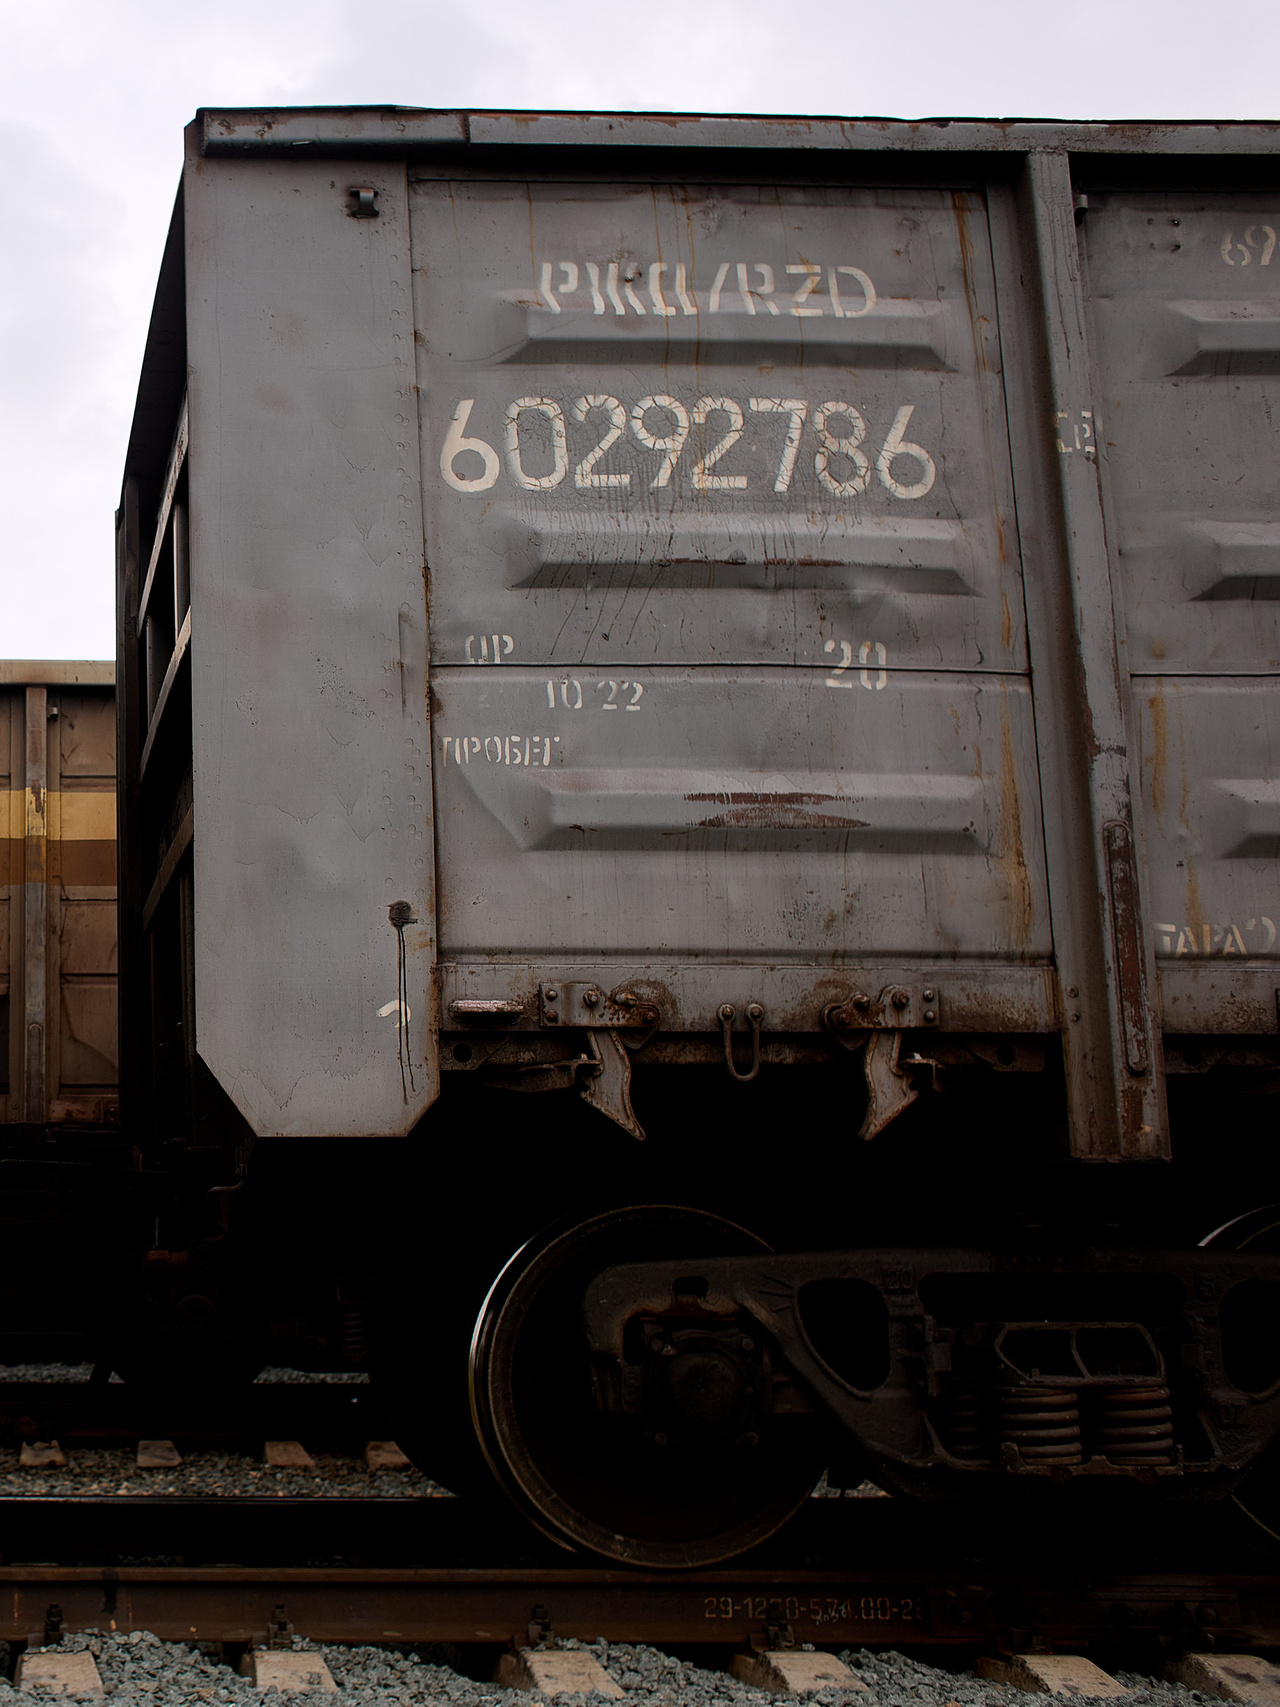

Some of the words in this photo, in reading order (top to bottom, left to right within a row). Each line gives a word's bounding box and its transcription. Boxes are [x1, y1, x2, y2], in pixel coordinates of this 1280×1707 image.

[440, 394, 936, 499] 60292786
[824, 639, 887, 690] 20
[546, 679, 582, 709] 10
[597, 680, 643, 711] 22
[442, 736, 561, 768] ПРОБЕГ
